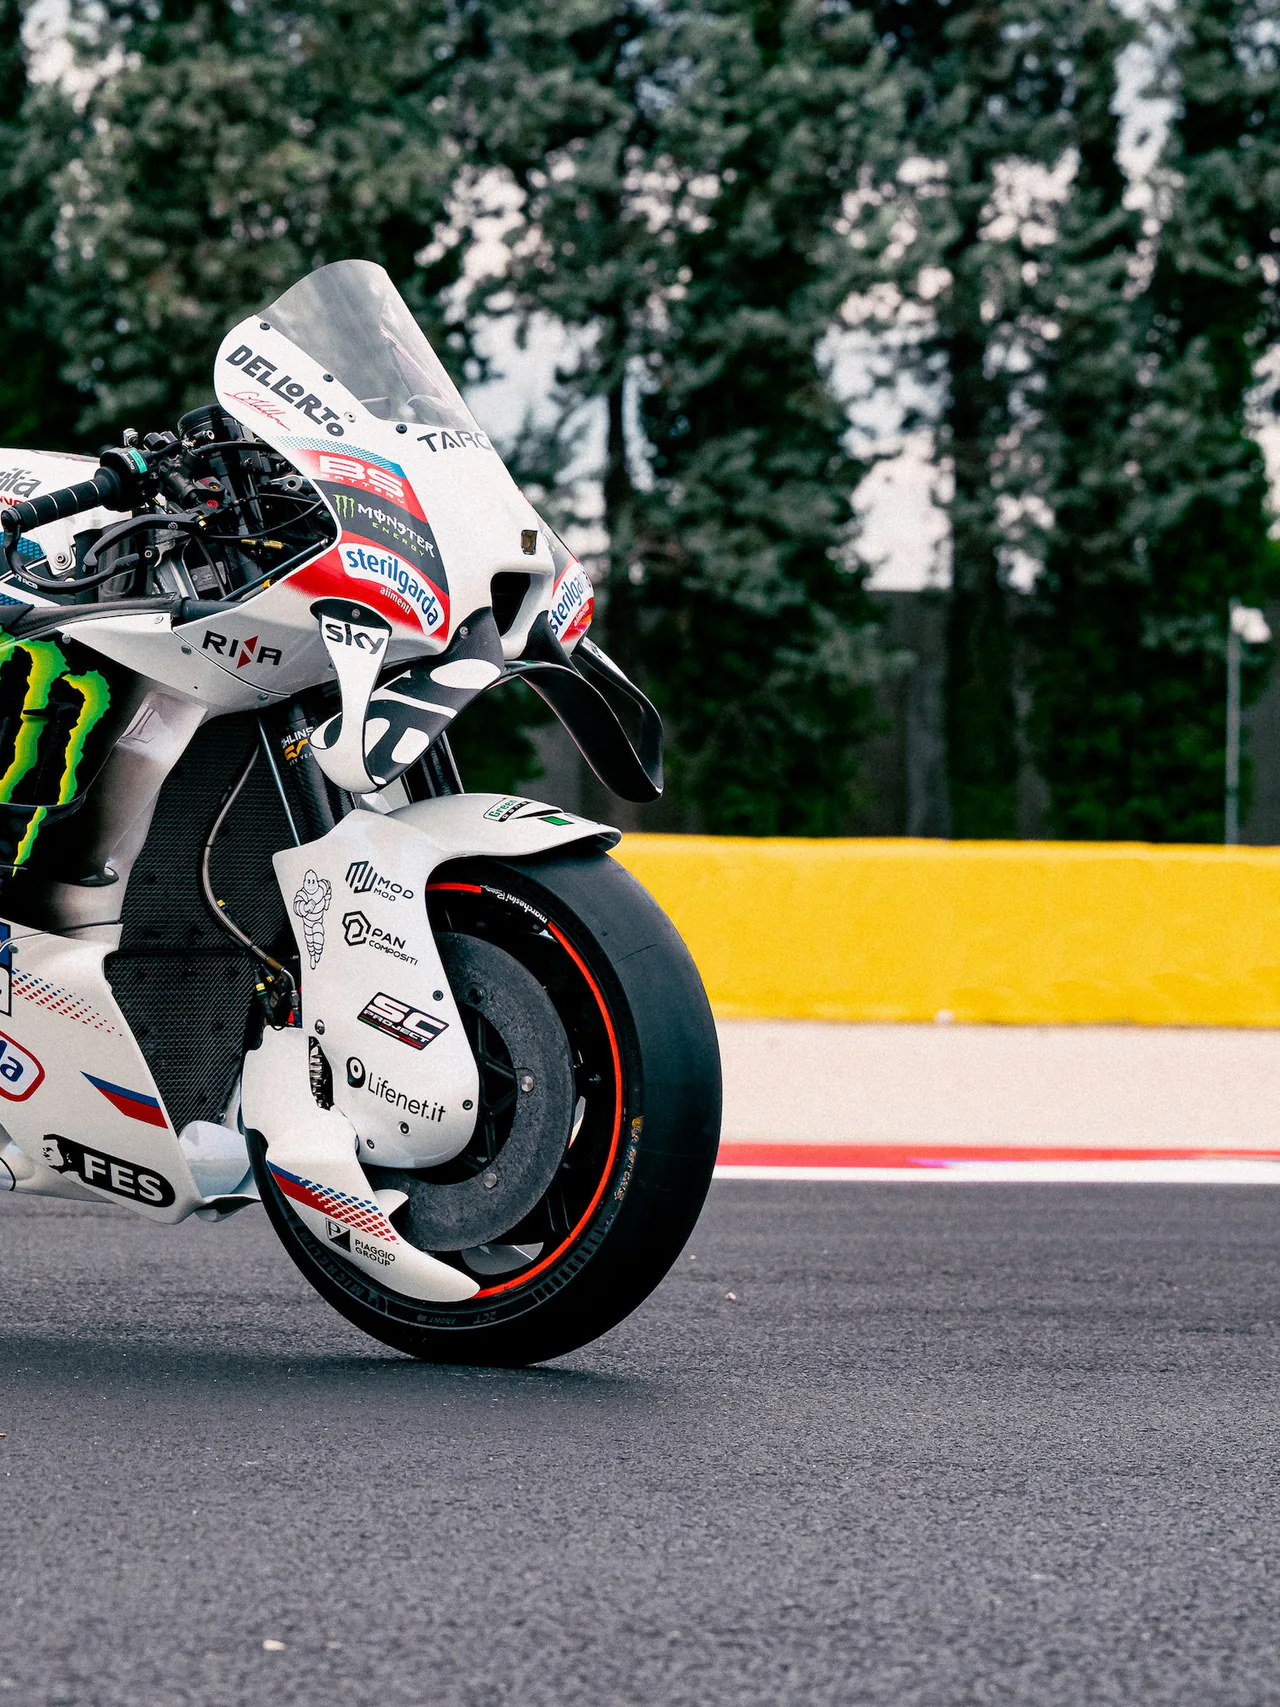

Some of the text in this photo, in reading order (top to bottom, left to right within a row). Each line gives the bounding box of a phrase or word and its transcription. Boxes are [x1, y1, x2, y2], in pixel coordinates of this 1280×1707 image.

[320, 455, 404, 498] BS
[372, 521, 425, 557] ENERGY
[346, 548, 439, 627] sterilgarda
[380, 587, 411, 616] alimenti
[325, 621, 385, 655] sky
[373, 887, 396, 902] MOD
[377, 876, 414, 899] MOD
[505, 892, 548, 924] marchesini
[368, 939, 418, 966] COMPOSITI
[371, 928, 406, 950] PAN
[362, 1008, 430, 1043] PROJECT
[365, 993, 447, 1039] SC
[367, 1071, 447, 1123] Lifenet.it
[82, 1151, 164, 1204] FES
[355, 1239, 396, 1262] PIAGGIO
[355, 1247, 391, 1266] GROUP
